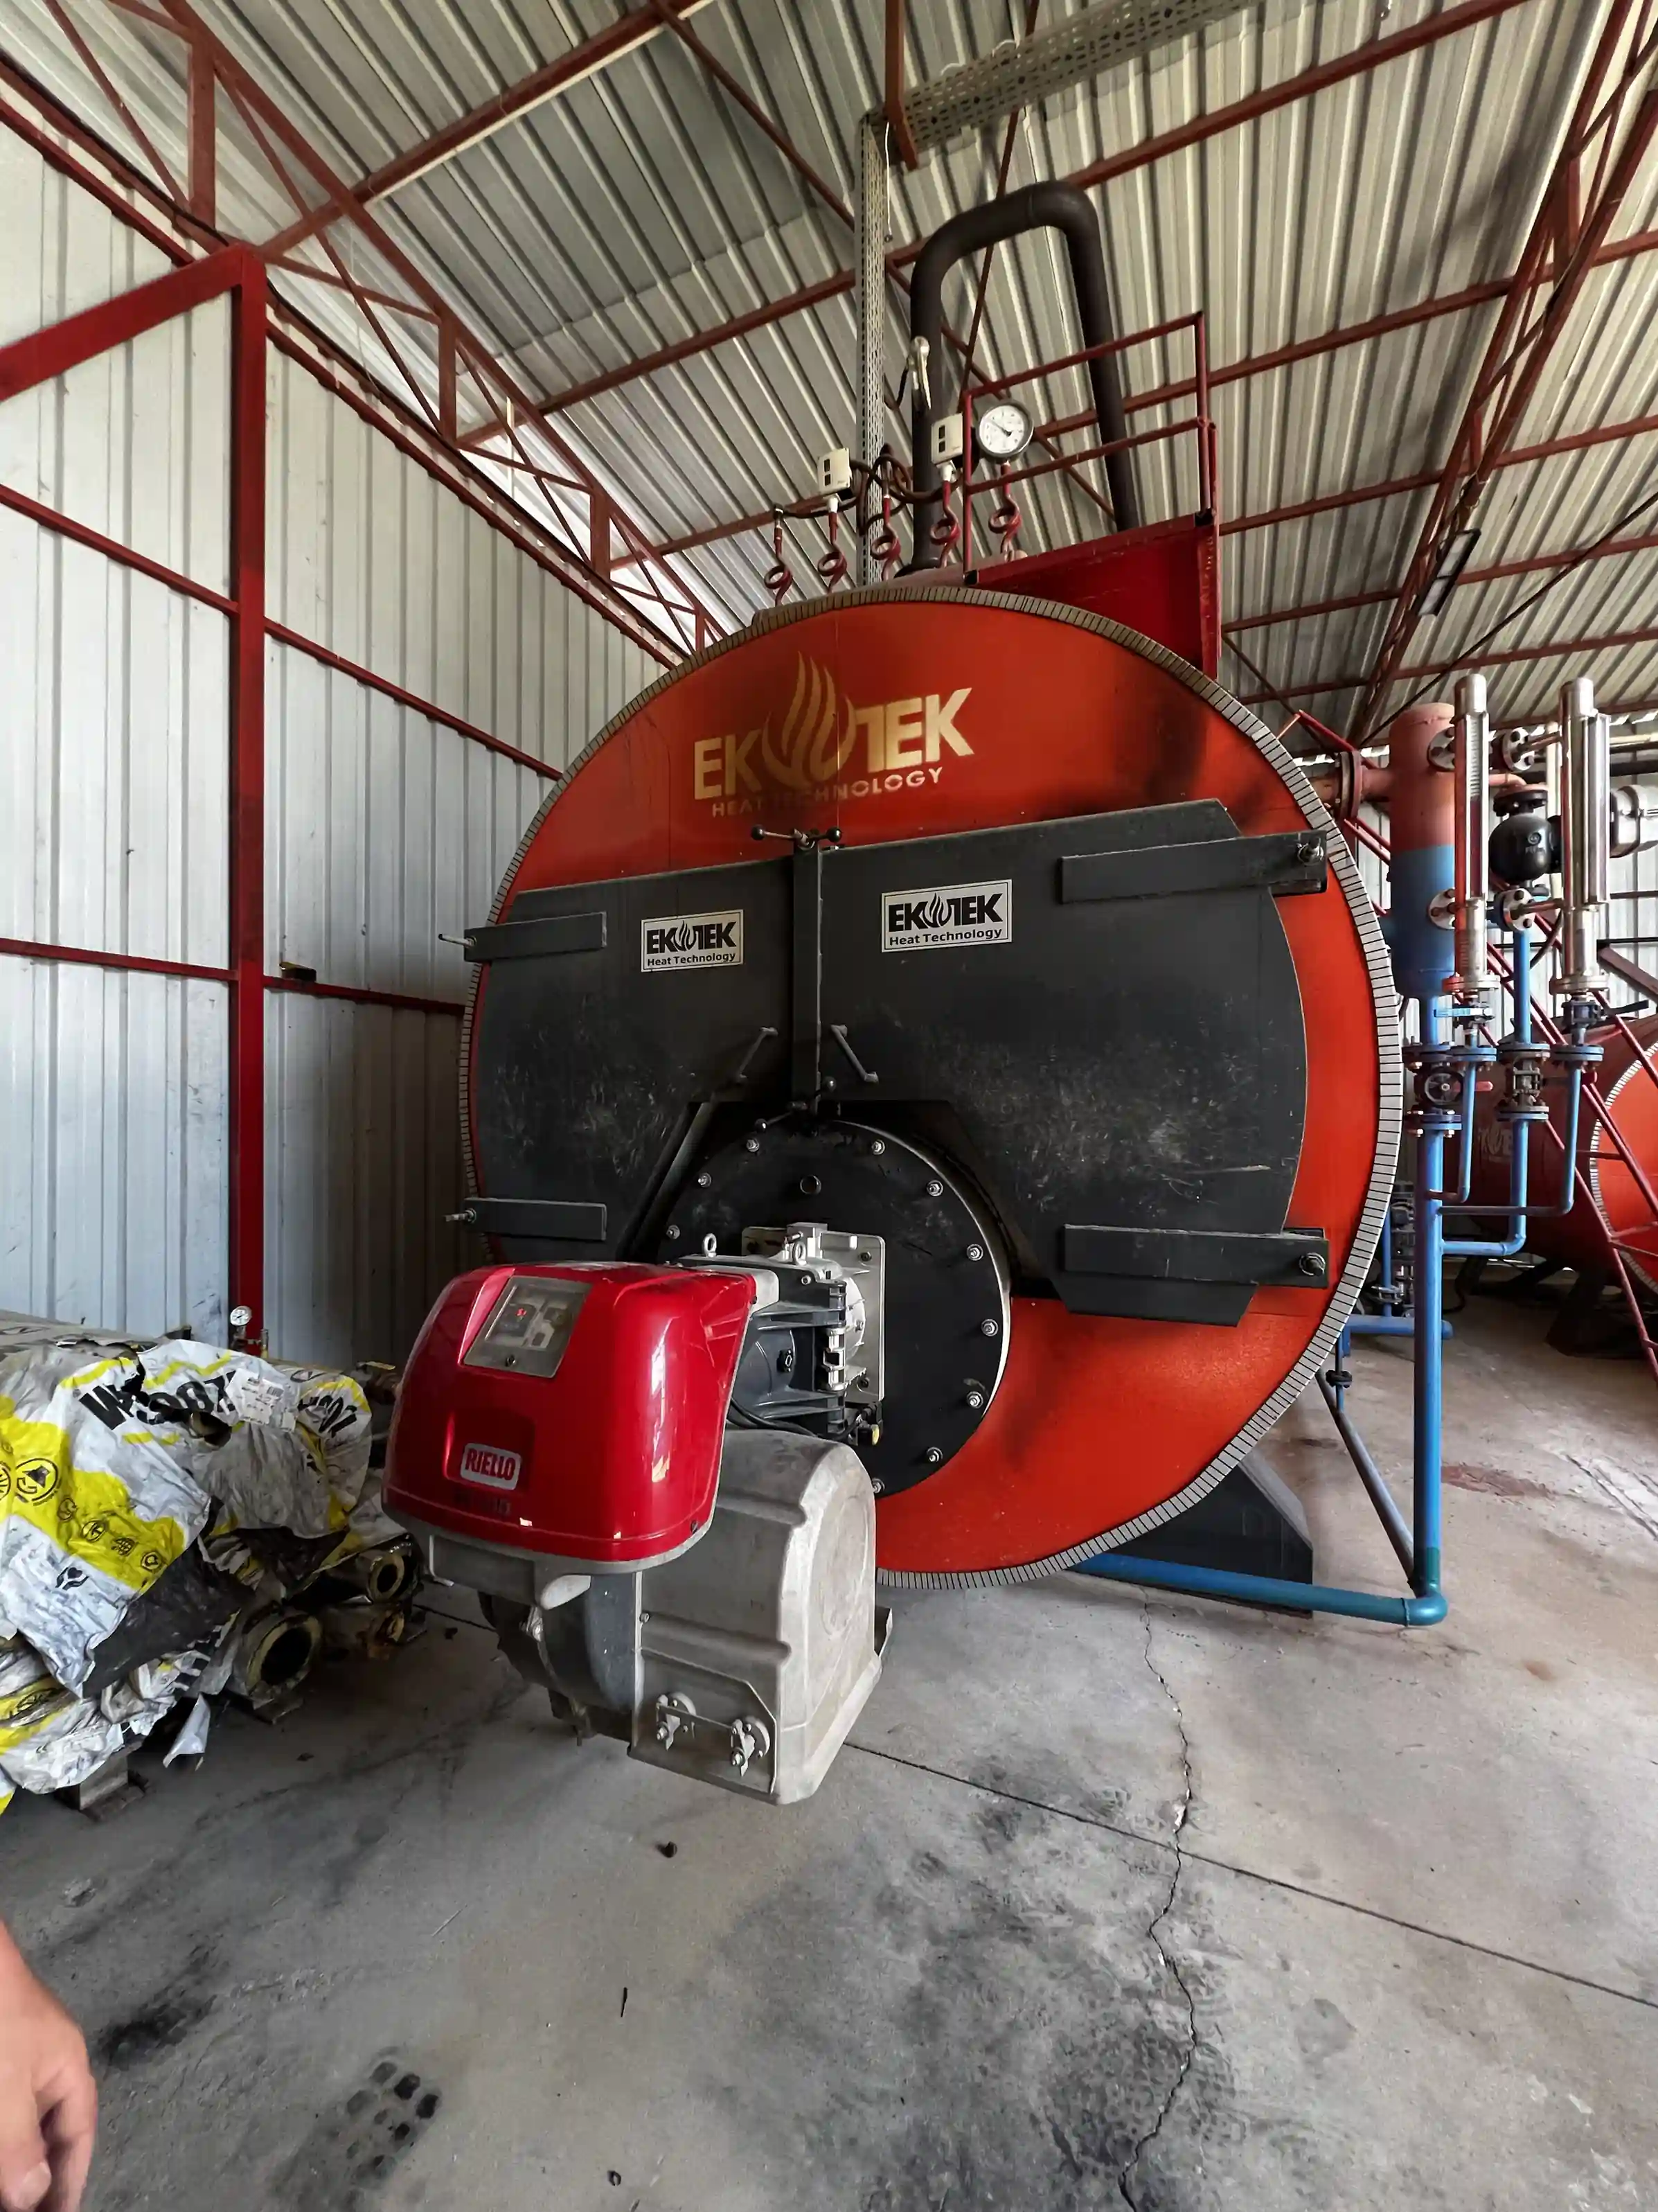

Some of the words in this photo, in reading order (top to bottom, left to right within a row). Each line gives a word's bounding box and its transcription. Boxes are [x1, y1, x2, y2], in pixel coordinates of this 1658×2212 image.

[712, 799, 763, 818] HEAT
[889, 892, 1004, 932] EKOTEK
[647, 919, 737, 954] EKOTEK
[889, 935, 920, 946] Heat
[922, 928, 1002, 943] Technology
[648, 956, 672, 966] Heat
[673, 953, 736, 964] Technology
[465, 1448, 516, 1481] RIELLO
